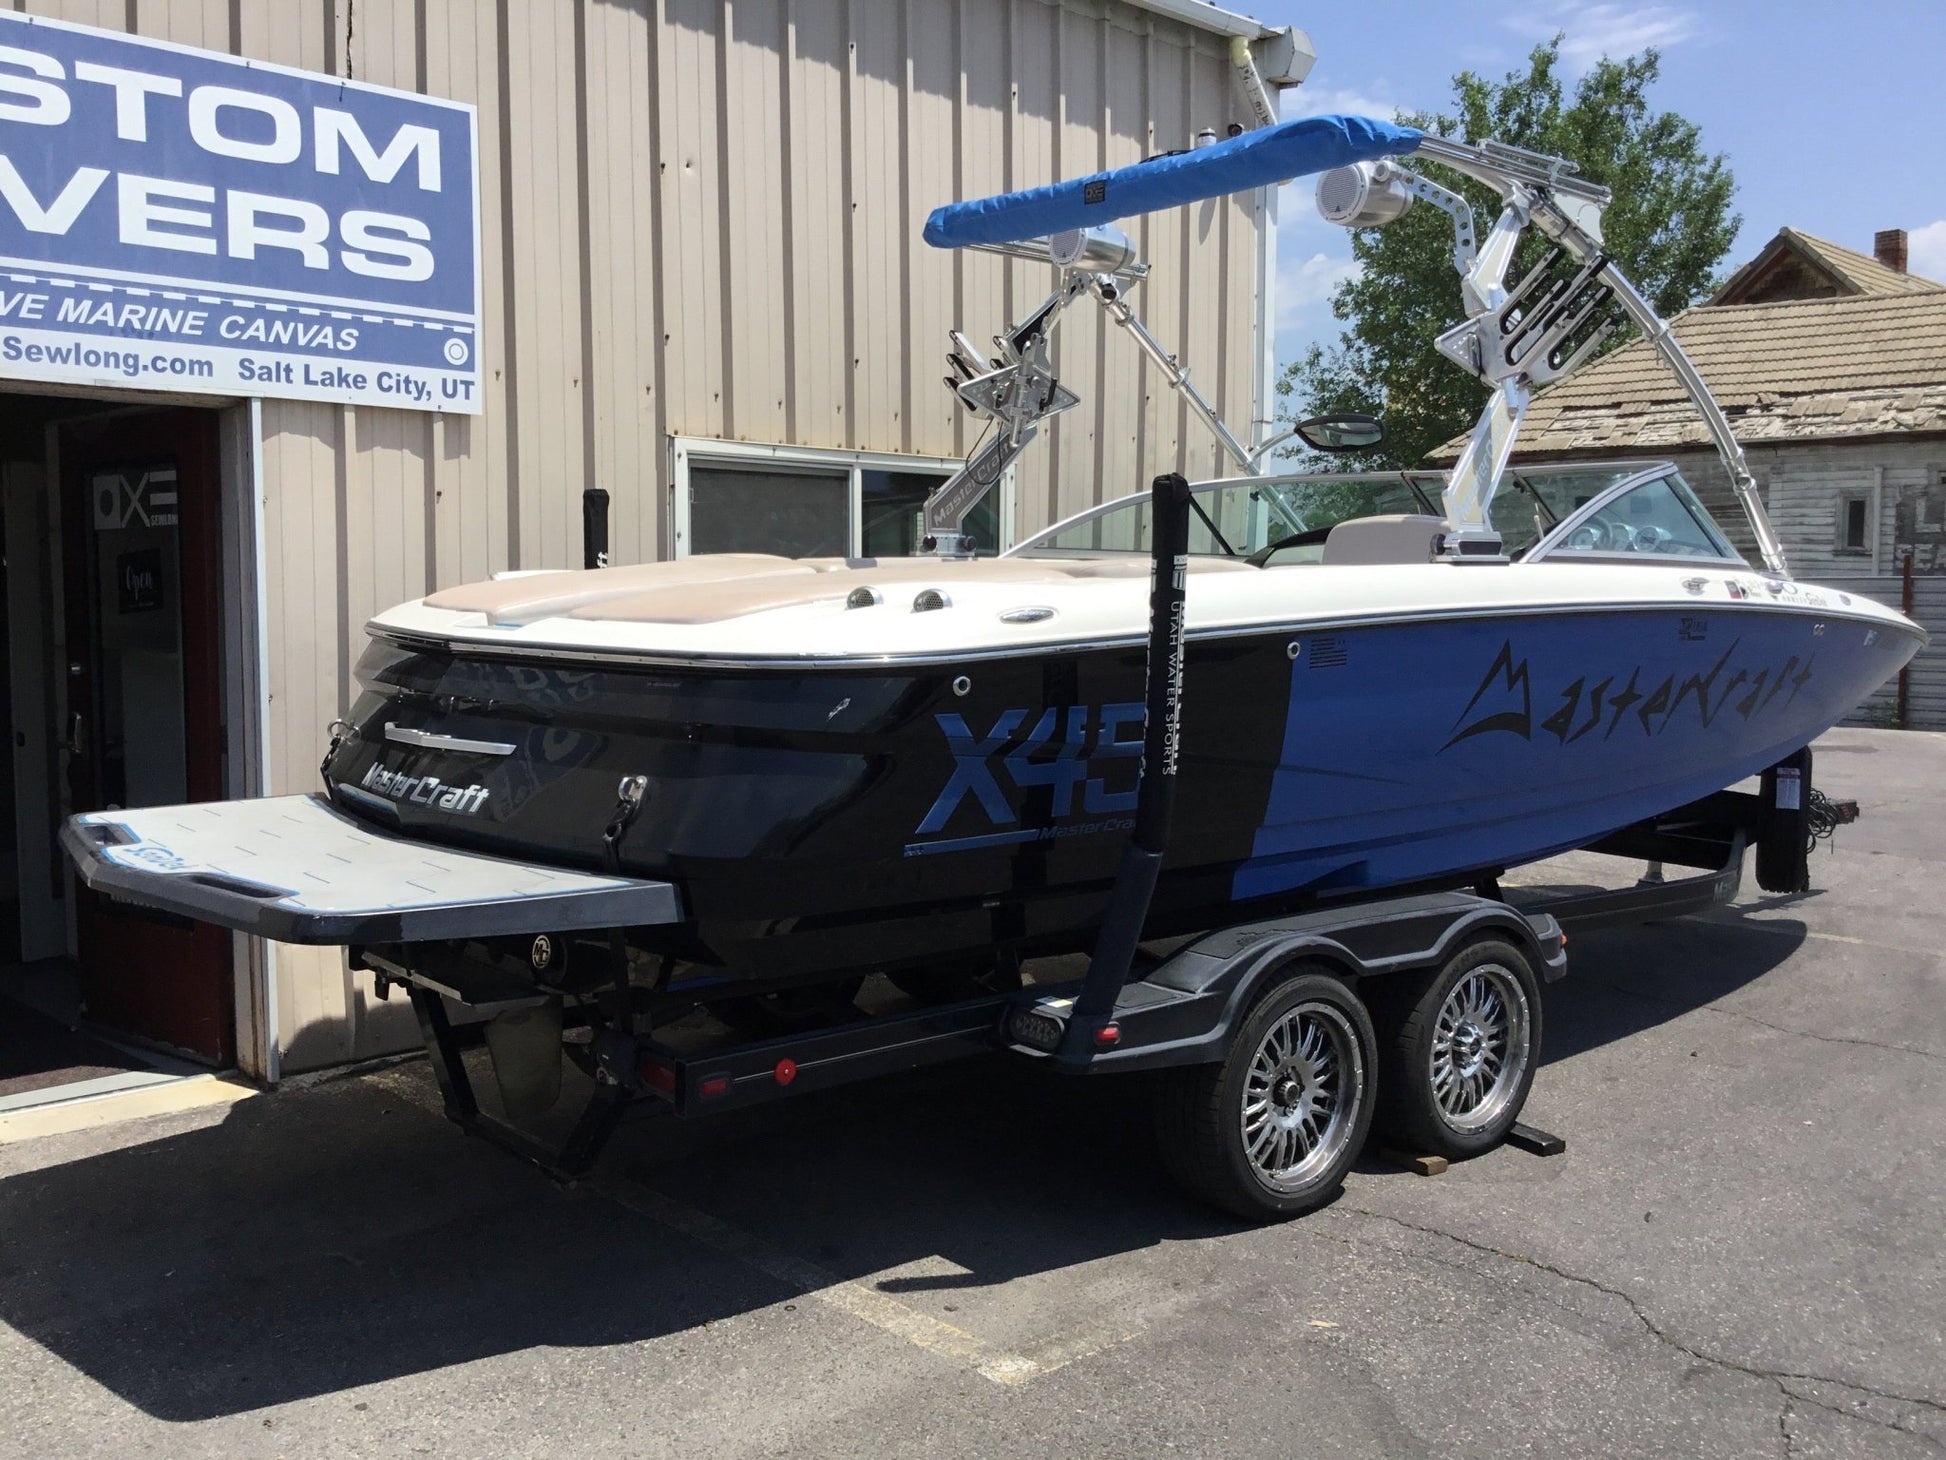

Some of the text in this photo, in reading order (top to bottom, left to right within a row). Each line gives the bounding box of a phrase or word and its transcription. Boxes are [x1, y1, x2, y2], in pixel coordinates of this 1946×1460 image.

[0, 45, 441, 193] STOM
[0, 154, 435, 282] VERS
[56, 297, 209, 335] MARINE
[220, 315, 360, 351] CANVAS
[3, 335, 475, 401] Sewlong.com Salt Lake City, UT
[1169, 600, 1180, 645] UTAH
[1166, 652, 1178, 707] WATER
[1162, 713, 1175, 776] SPORTS
[361, 762, 490, 813] MasterCraft
[1039, 818, 1137, 840] MasterCra
